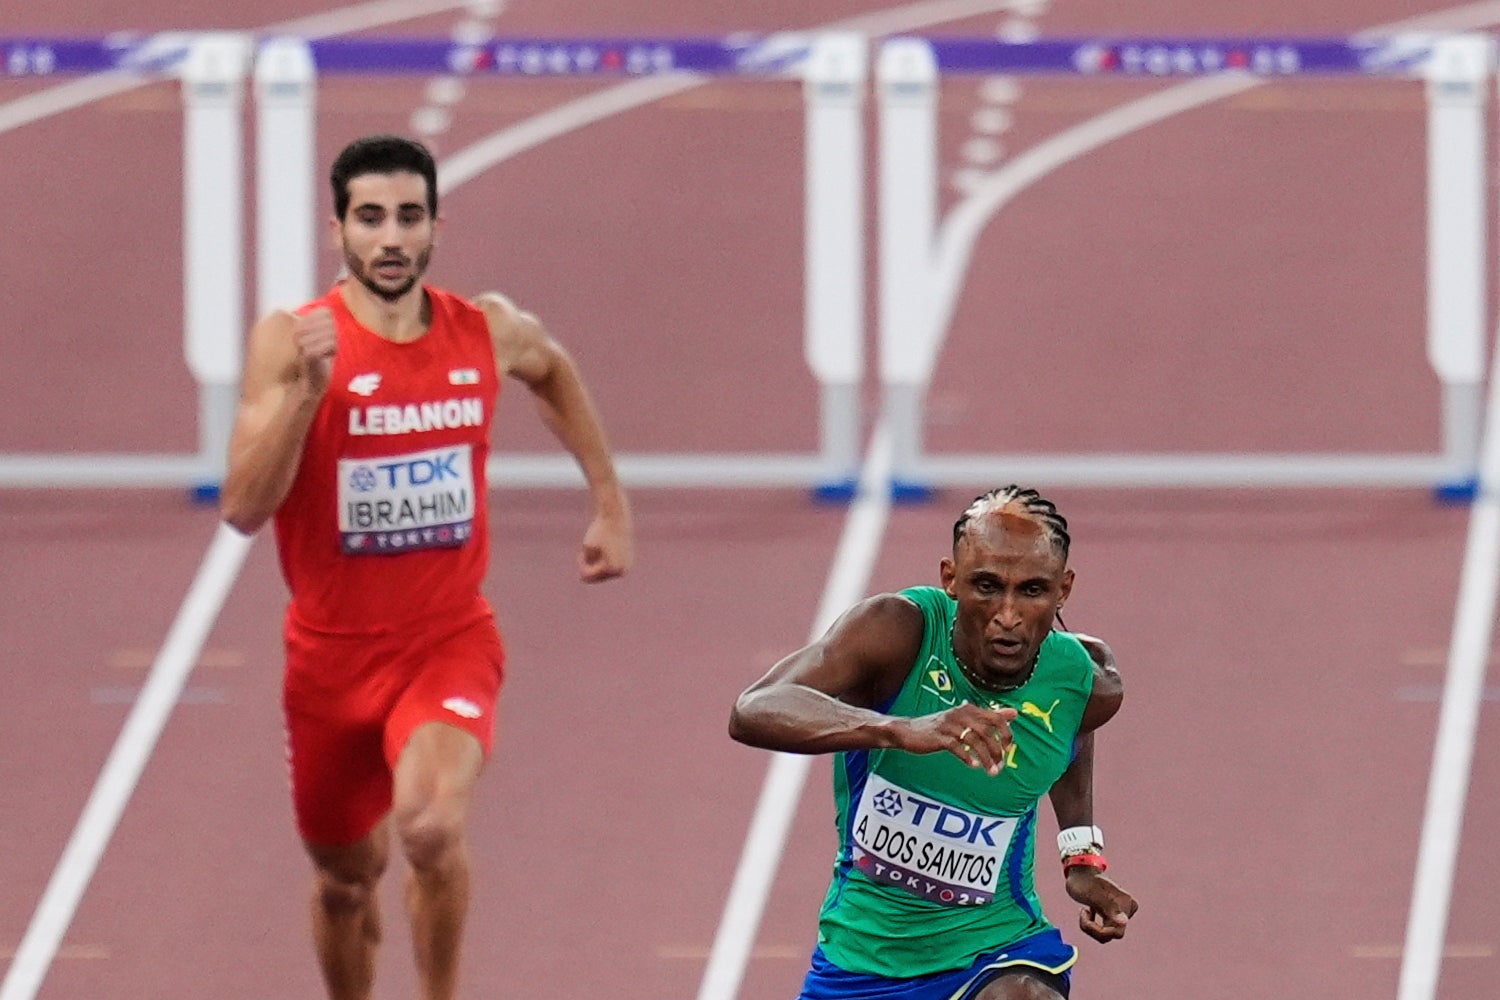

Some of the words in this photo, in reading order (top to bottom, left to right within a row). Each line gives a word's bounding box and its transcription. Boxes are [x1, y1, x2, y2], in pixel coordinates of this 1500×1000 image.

[348, 398, 483, 435] LEBANON
[377, 452, 459, 488] TDK
[348, 488, 467, 529] IBRAHIM
[907, 796, 1006, 847] TDK
[856, 815, 869, 845] A.
[872, 825, 917, 865] DOS
[917, 841, 996, 886] SANTOS
